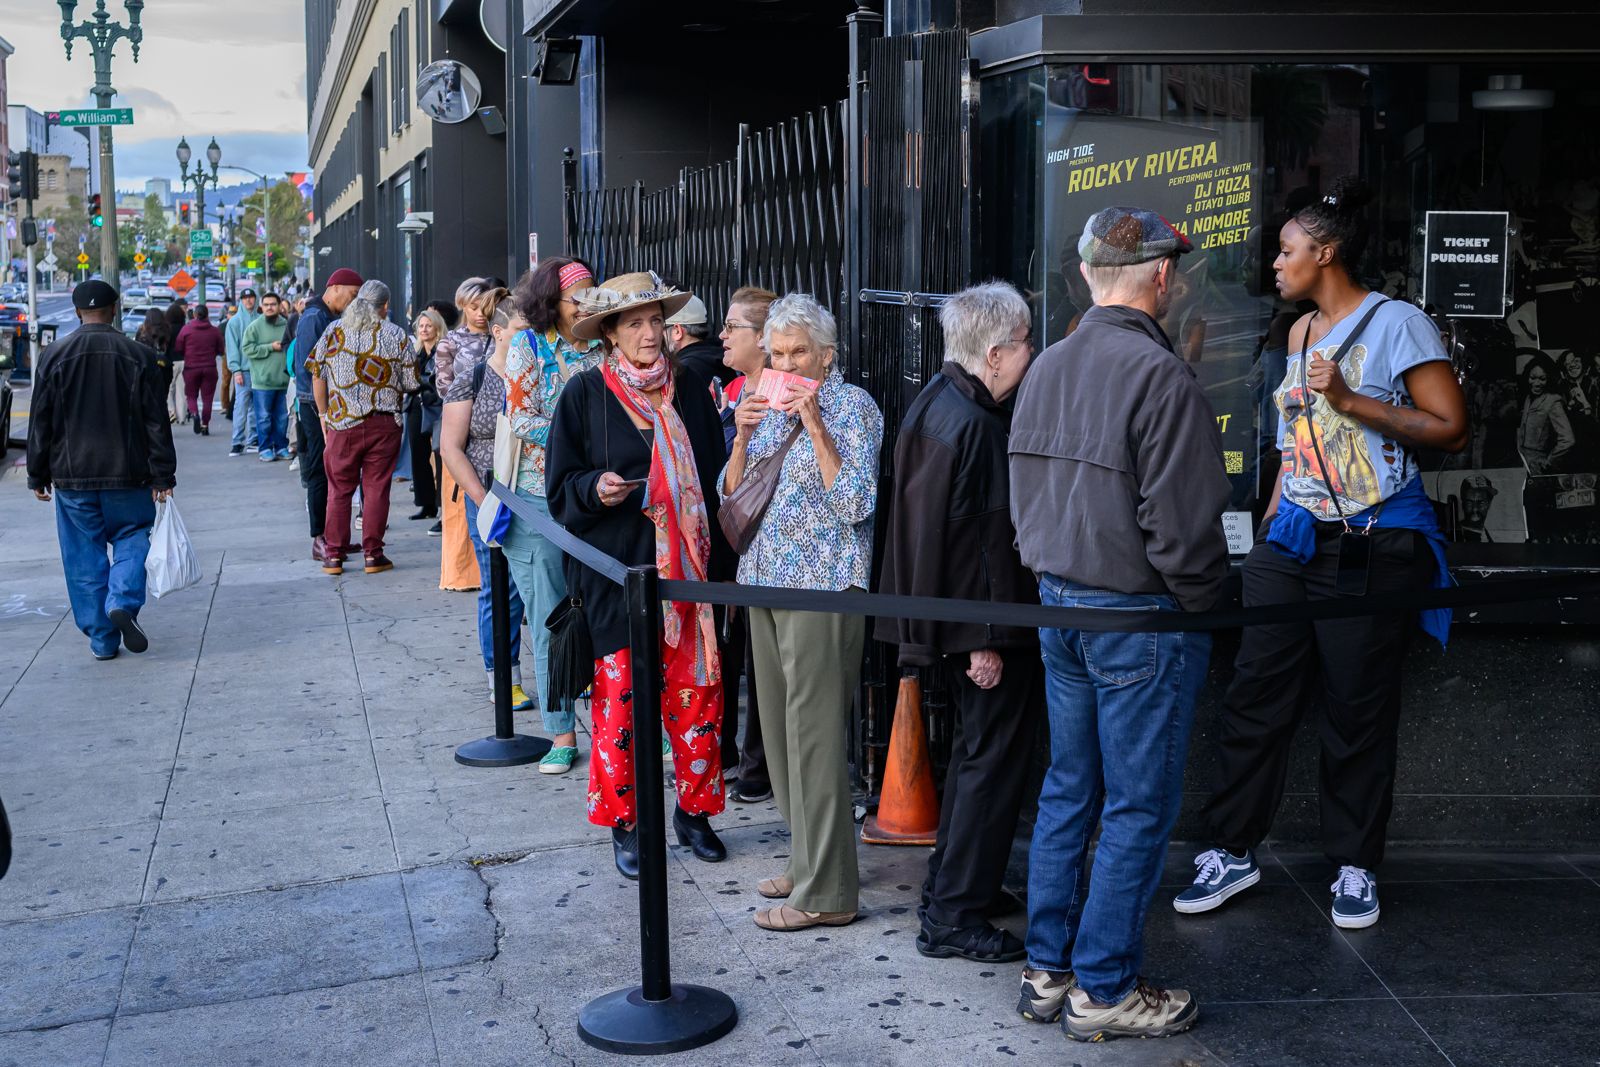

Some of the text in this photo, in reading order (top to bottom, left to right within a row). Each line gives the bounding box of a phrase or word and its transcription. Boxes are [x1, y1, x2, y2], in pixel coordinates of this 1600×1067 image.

[78, 112, 116, 124] William
[1047, 143, 1095, 164] HIGH TIDE
[1068, 156, 1094, 167] PRESENTS
[1067, 141, 1218, 194] ROCKY RIVERA
[1168, 162, 1252, 186] PERFORMING LIVE WITH
[1194, 175, 1250, 199] DJ ROZA
[1185, 191, 1251, 214] & OTAYO DUBB
[1171, 208, 1251, 237] IA NOMORE
[1201, 226, 1251, 250] JENSET
[1443, 238, 1490, 248] TICKET
[1430, 253, 1499, 263] PURCHASE
